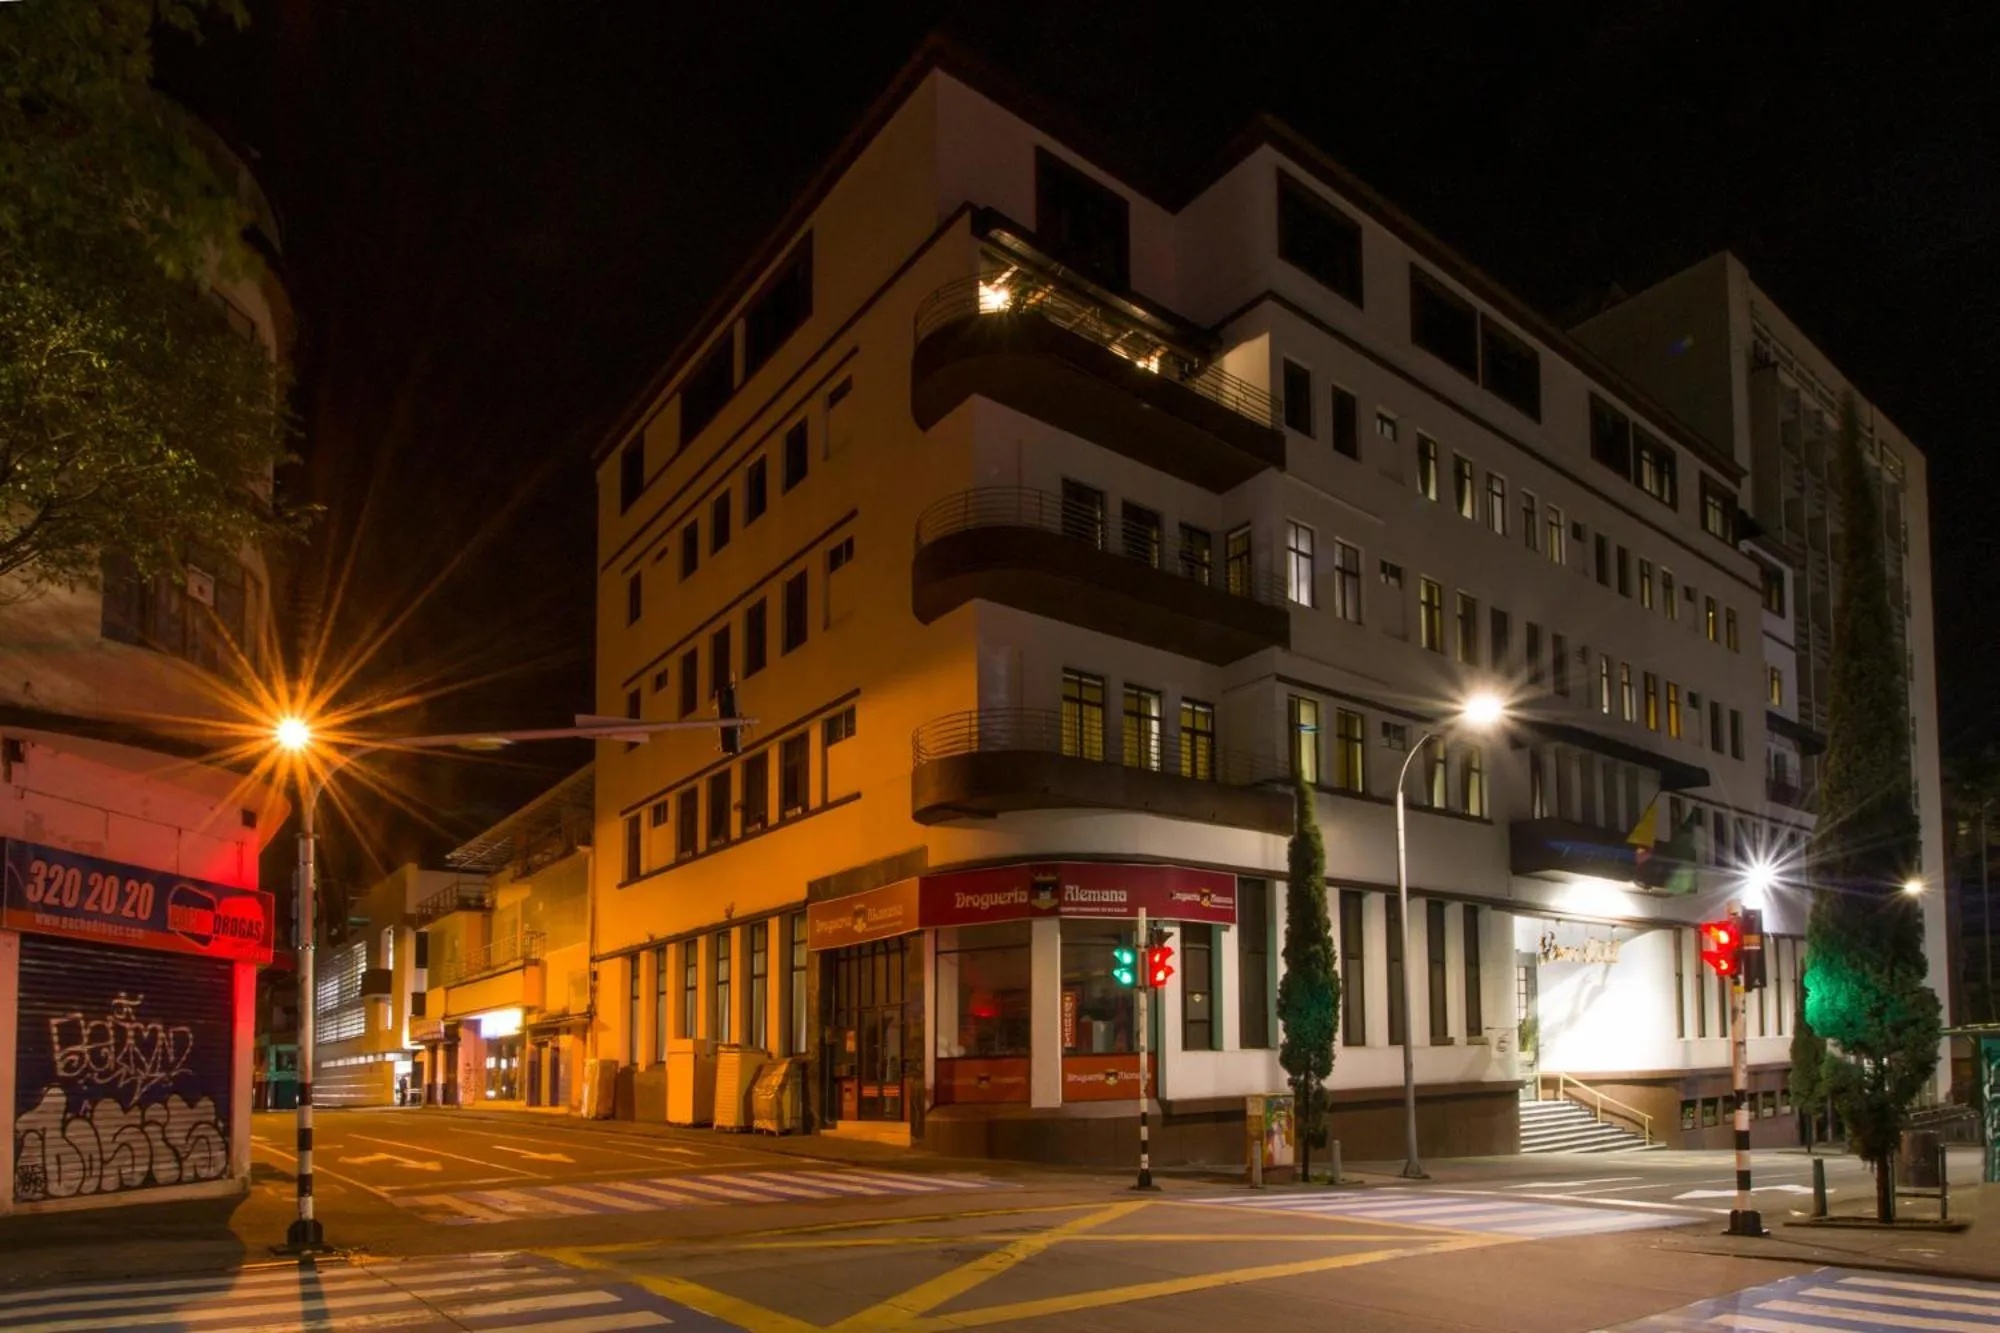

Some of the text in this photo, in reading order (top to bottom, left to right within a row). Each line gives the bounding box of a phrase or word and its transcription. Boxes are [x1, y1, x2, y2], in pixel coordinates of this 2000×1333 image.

[26, 860, 155, 921] 320 20 20
[1064, 885, 1128, 903] Alemana
[213, 913, 262, 941] DROGAS
